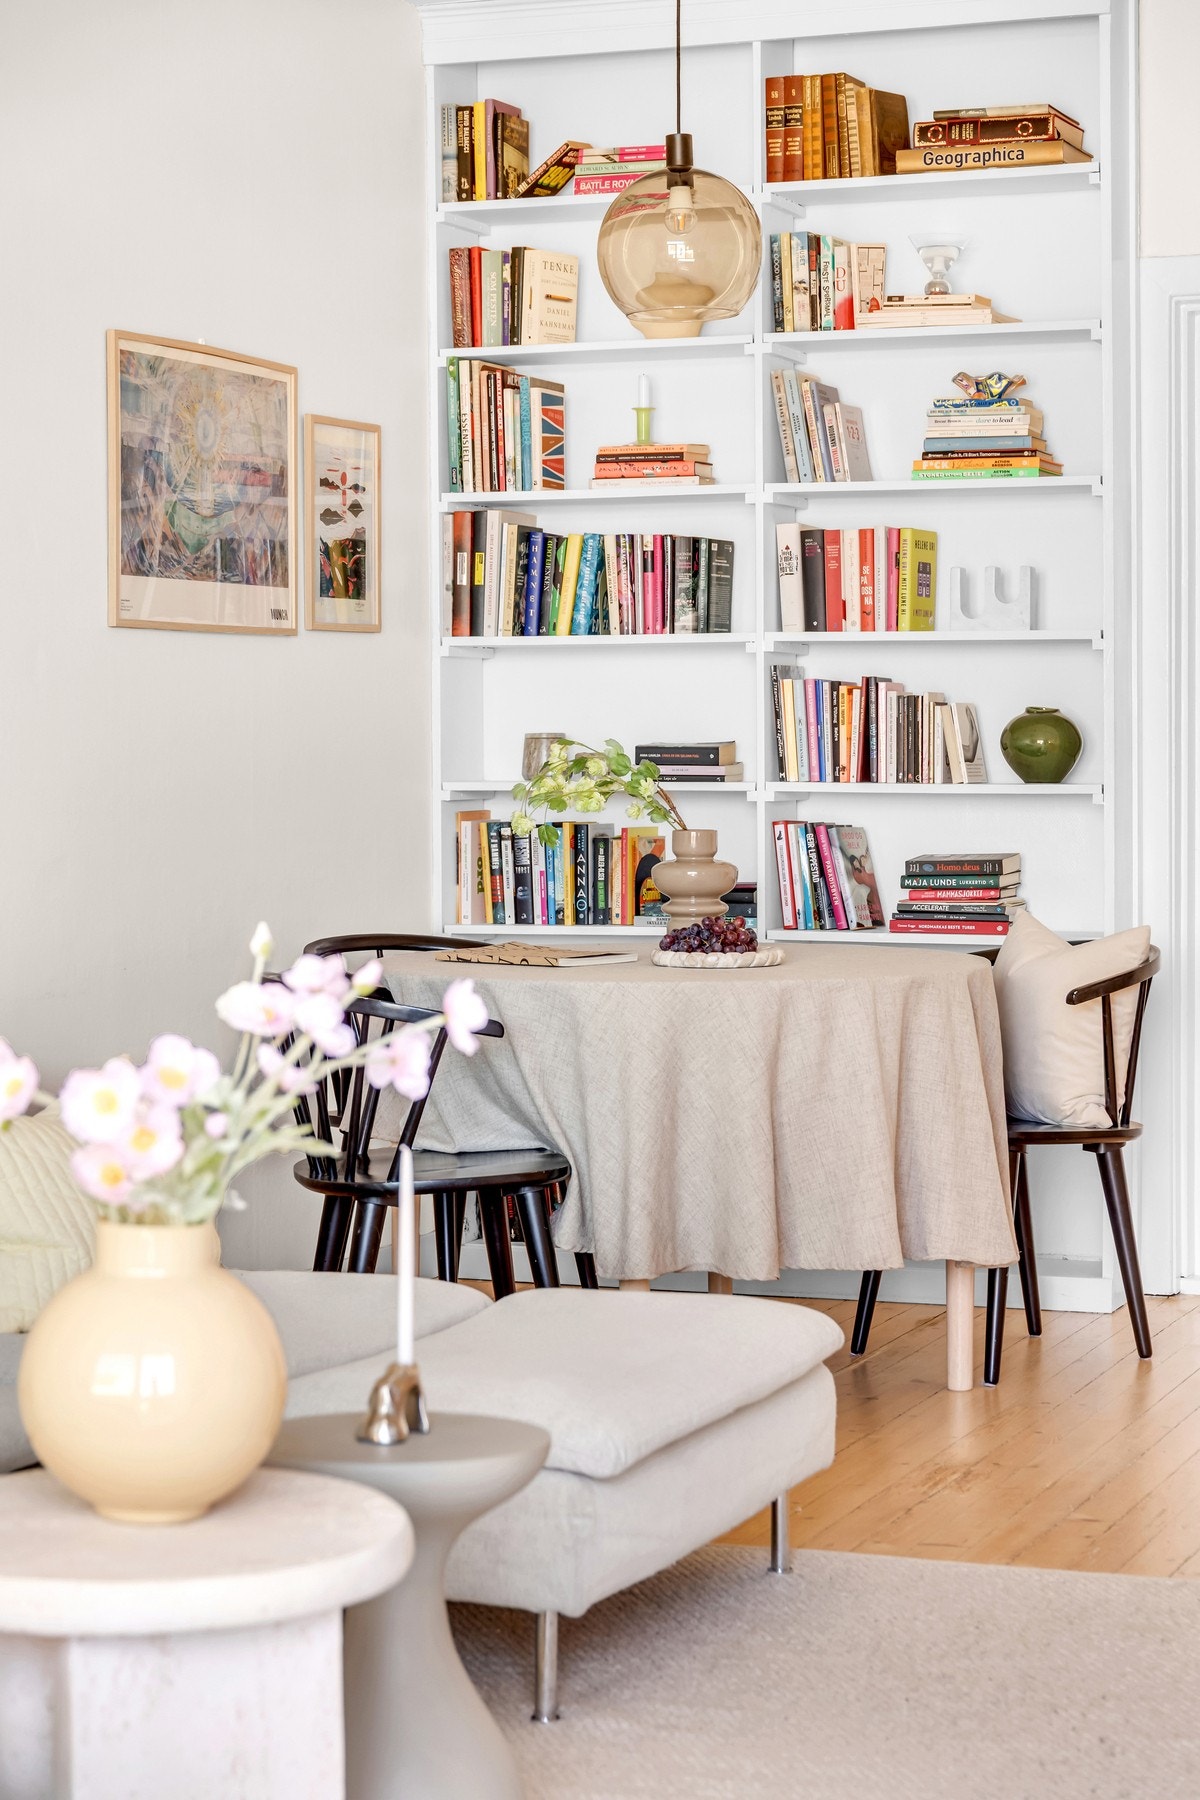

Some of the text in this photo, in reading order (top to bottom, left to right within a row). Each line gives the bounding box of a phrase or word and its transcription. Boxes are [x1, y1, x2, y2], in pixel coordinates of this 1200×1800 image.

[923, 147, 1024, 168] Geographica
[580, 180, 611, 190] BATTLE
[547, 307, 570, 317] DANIEL
[461, 413, 470, 463] ESSENSIELT
[862, 565, 870, 575] SE
[861, 586, 873, 596] OSS
[490, 843, 499, 870] HAMMER
[806, 833, 820, 883] GEIR LIPPESTAD
[936, 863, 961, 872] Homo
[911, 903, 950, 912] ACCELERATE
